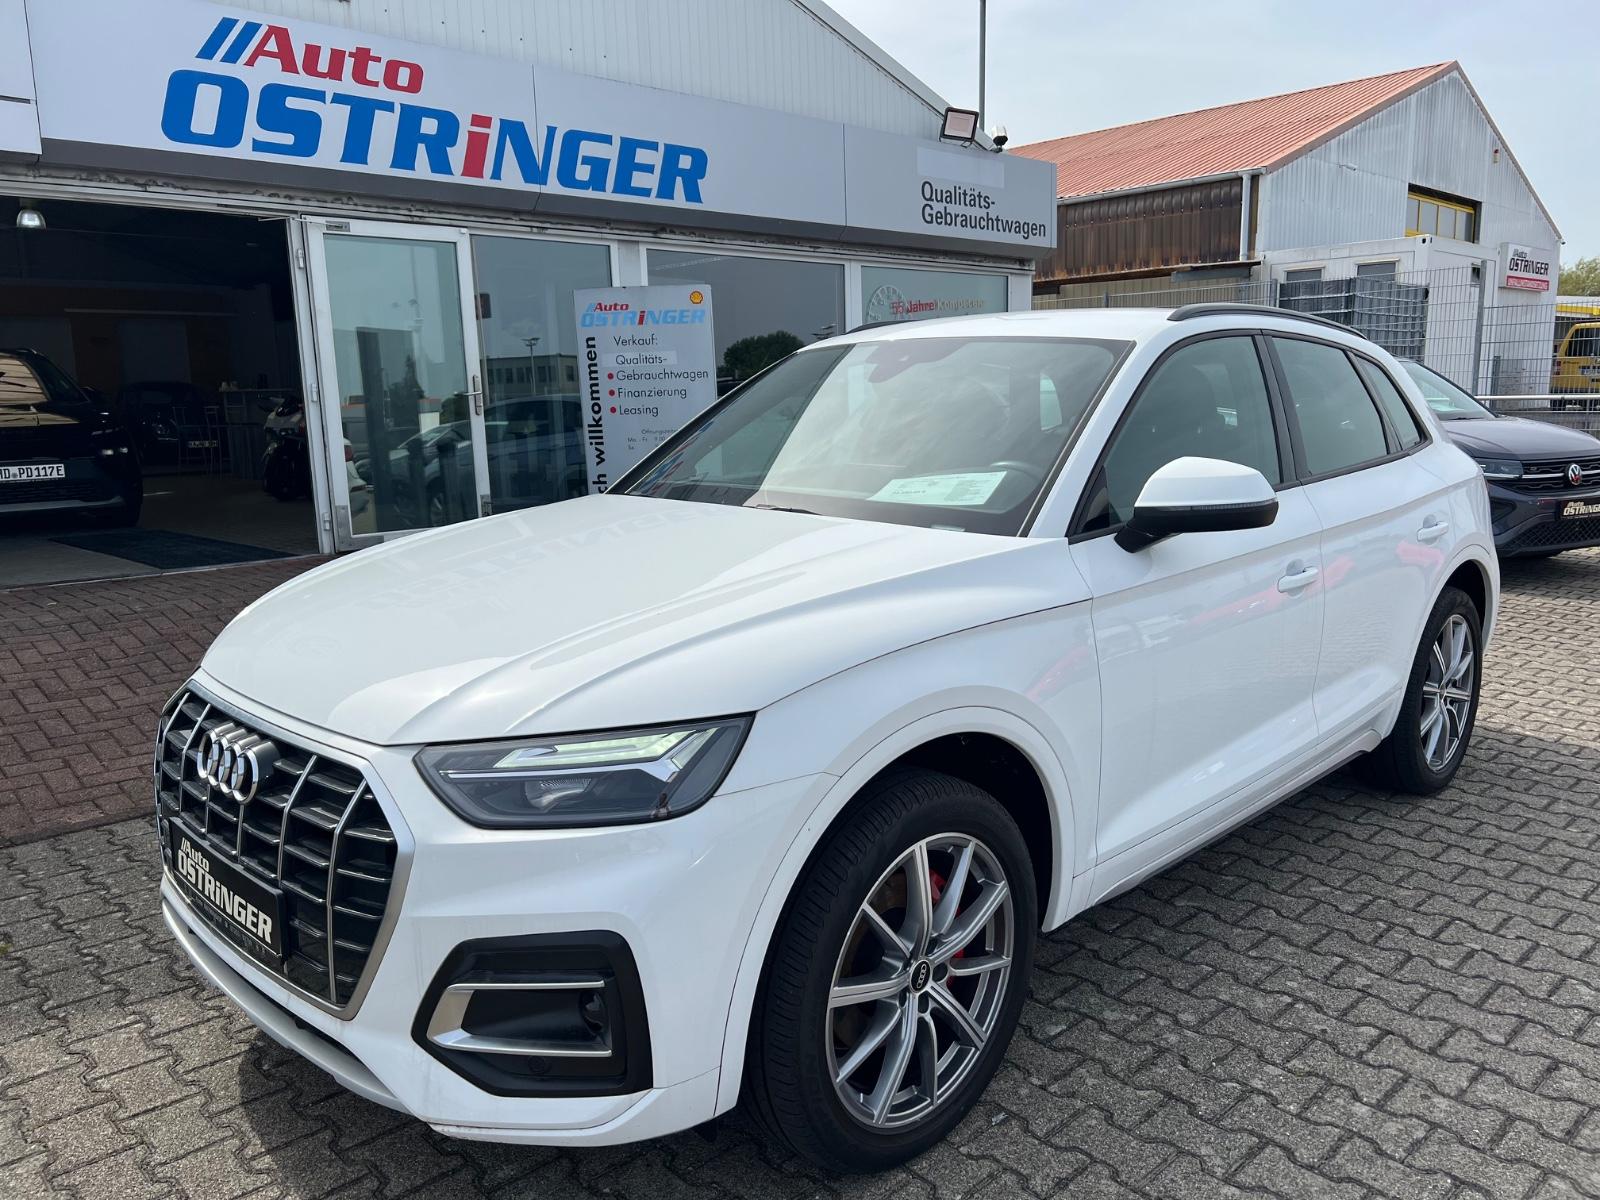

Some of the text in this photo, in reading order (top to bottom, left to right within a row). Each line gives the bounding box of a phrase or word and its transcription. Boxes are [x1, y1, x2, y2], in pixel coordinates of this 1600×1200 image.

[921, 180, 996, 209] Qualitäts-
[921, 203, 1047, 240] Gebrauchtwagen
[613, 334, 658, 347] Verkauf:
[615, 354, 668, 366] Qualitäts-
[616, 368, 709, 382] Gebrauchtwagen
[617, 386, 687, 399] Finanzierung
[585, 336, 608, 494] ch willkommen
[619, 404, 659, 417] Leasing
